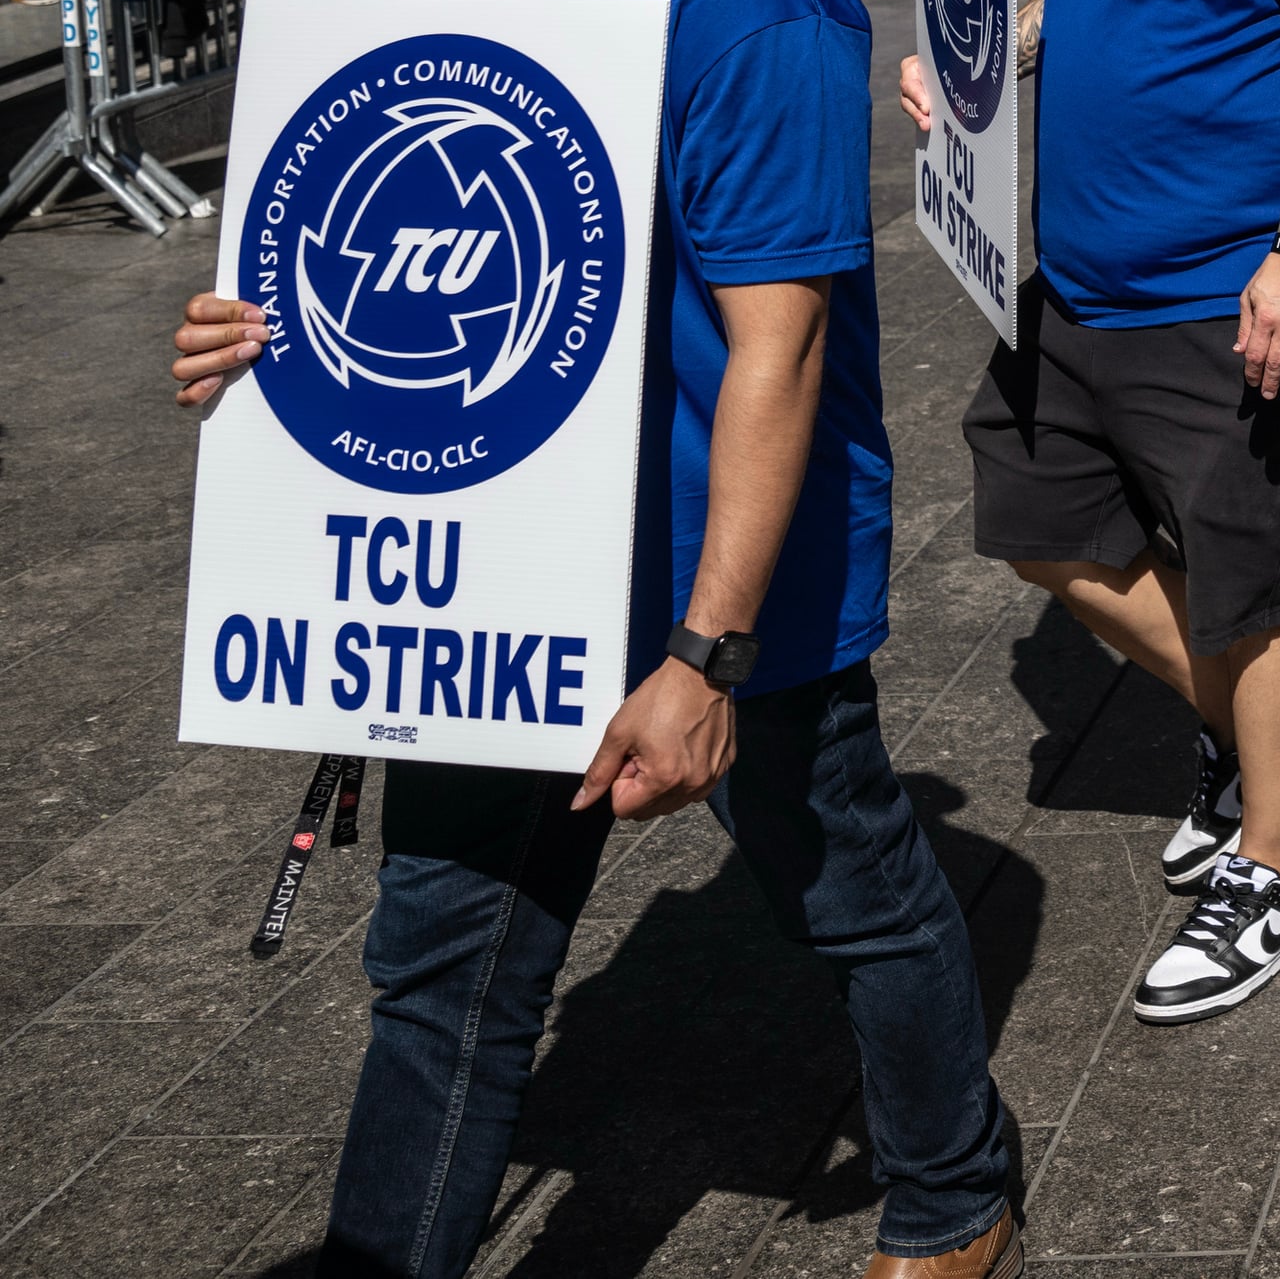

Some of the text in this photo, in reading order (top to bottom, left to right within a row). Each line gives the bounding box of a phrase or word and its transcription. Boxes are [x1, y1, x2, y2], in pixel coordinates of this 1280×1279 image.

[990, 9, 1004, 85] UNION
[943, 119, 974, 204] TCU
[257, 59, 605, 380] TRANSPORTATION COMMUNICATIONS UNION
[373, 227, 502, 296] TCU
[921, 159, 1006, 312] ON STRIKE
[325, 513, 462, 609] TCU
[213, 613, 588, 727] ON STRIKE
